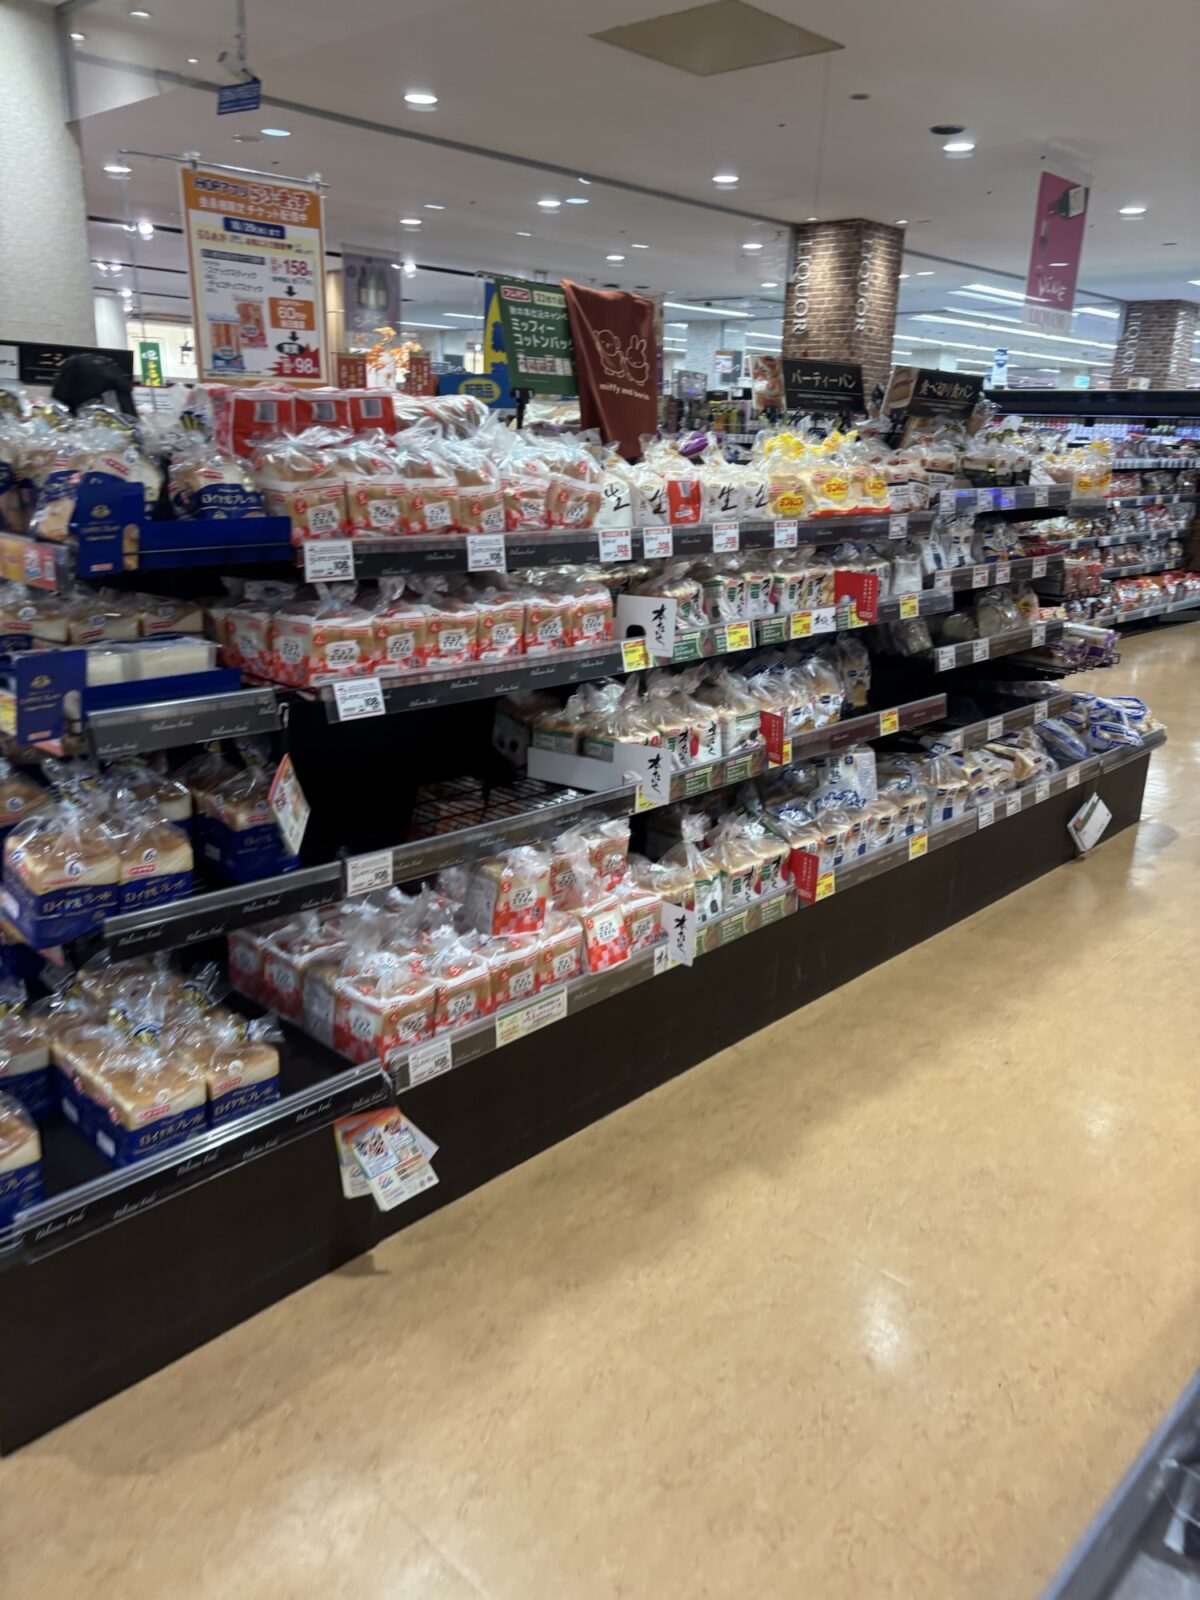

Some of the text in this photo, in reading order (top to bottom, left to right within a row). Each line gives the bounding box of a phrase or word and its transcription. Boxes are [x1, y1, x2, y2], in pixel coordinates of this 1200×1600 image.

[792, 241, 813, 334] LIQUOR
[853, 239, 873, 333] LIQUOR
[511, 318, 556, 334] ミッフィー
[599, 383, 621, 394] miffy
[791, 369, 857, 389] パーティーパン
[719, 482, 738, 511] 生
[142, 849, 156, 863] 6
